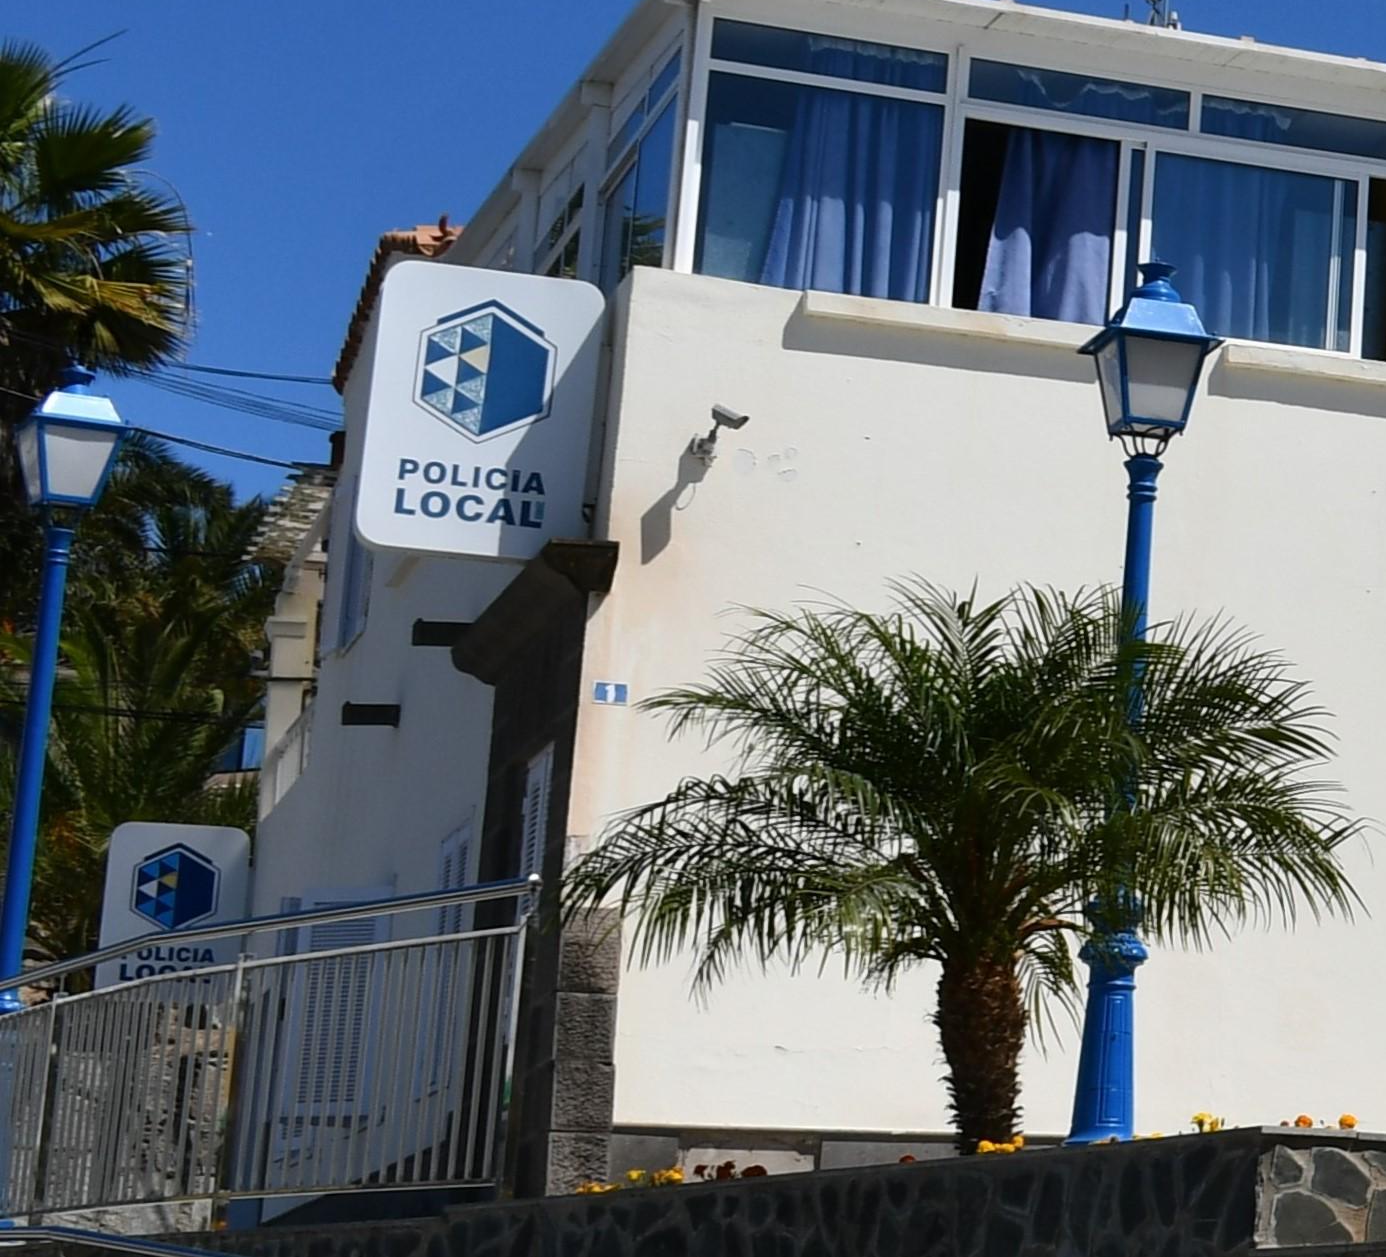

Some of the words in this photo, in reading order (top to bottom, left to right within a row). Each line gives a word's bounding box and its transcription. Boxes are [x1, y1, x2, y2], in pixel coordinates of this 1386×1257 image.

[398, 458, 545, 495] POLICIA
[394, 487, 545, 529] LOCAL
[120, 946, 214, 963] OLICIA
